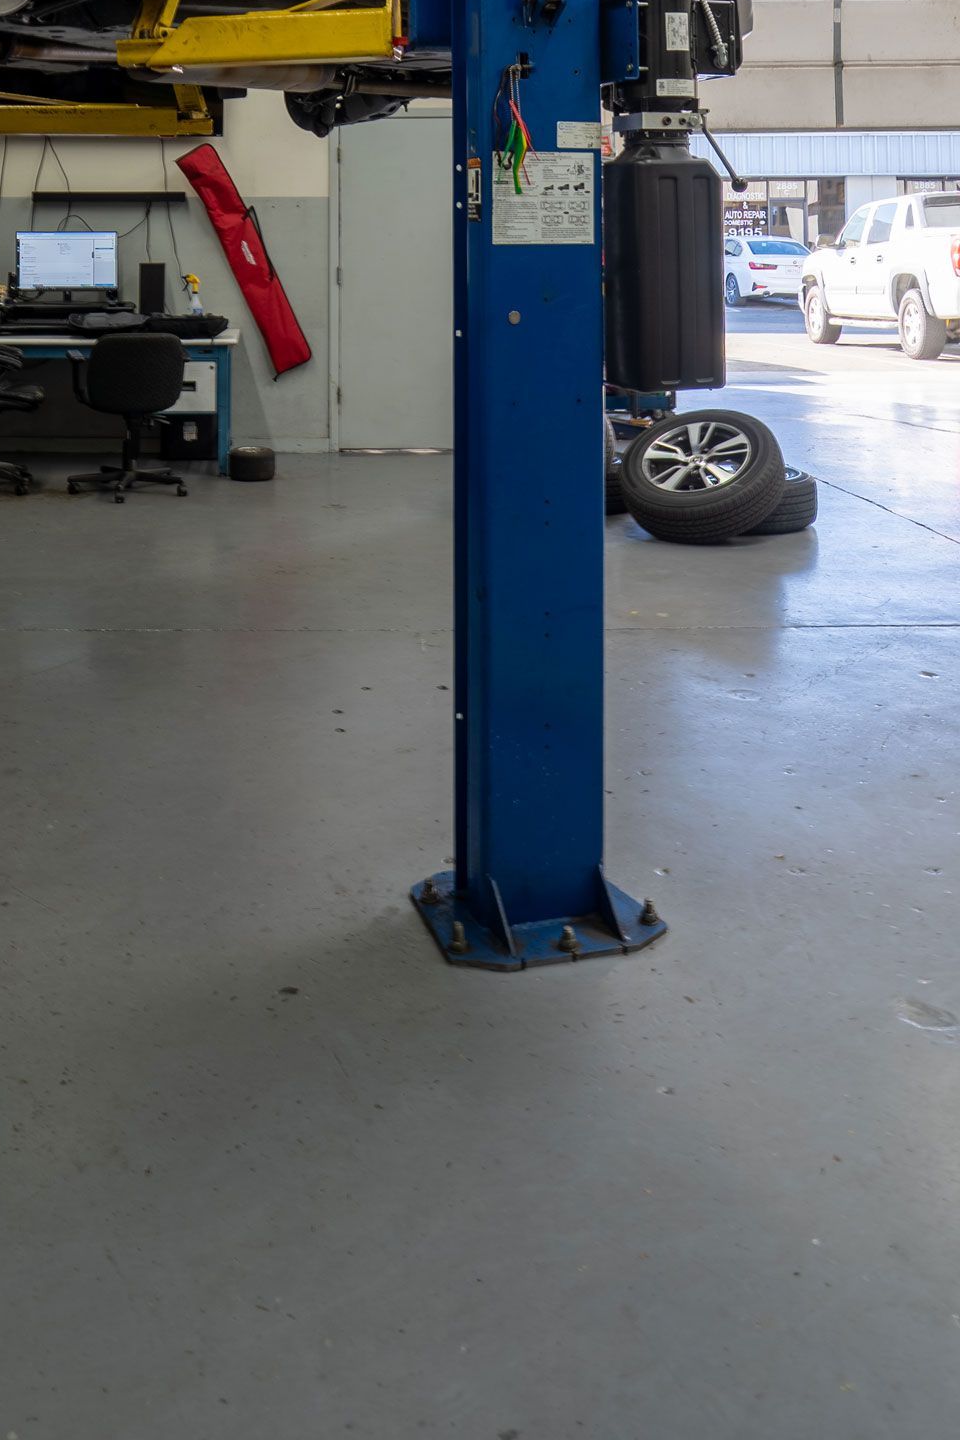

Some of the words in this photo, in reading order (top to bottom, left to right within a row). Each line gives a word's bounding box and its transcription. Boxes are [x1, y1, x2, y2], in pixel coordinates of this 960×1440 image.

[727, 192, 765, 200] DIAGNOSTIC
[742, 201, 748, 209] &
[724, 210, 742, 219] AUTO
[743, 210, 767, 219] REPAIR
